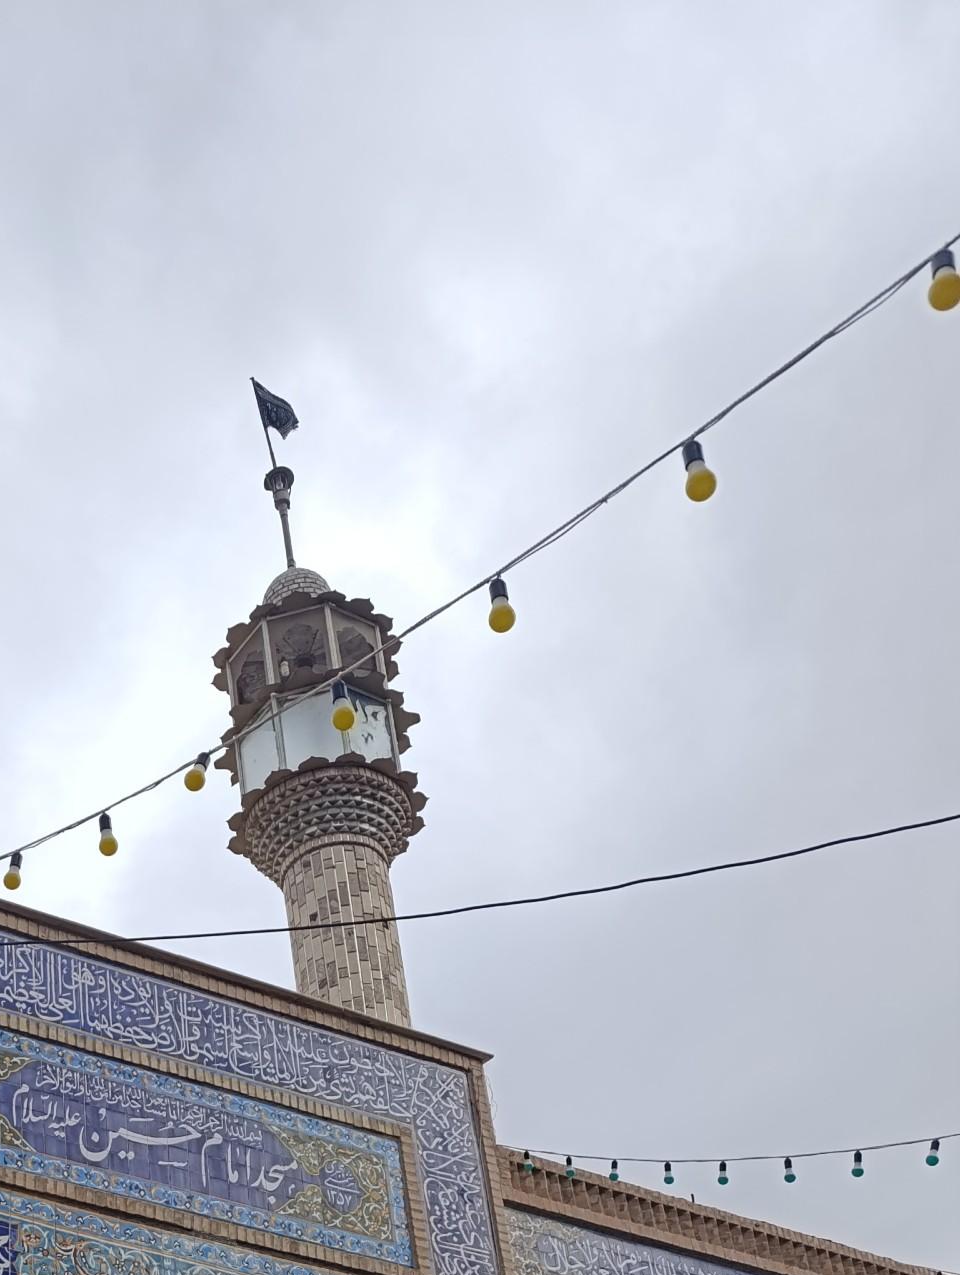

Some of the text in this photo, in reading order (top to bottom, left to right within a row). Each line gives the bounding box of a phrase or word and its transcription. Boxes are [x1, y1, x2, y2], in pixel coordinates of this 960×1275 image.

[13, 1083, 298, 1203] مسجد امام حسین علیه السلام
[327, 1189, 352, 1206] ۱۳۵۷
